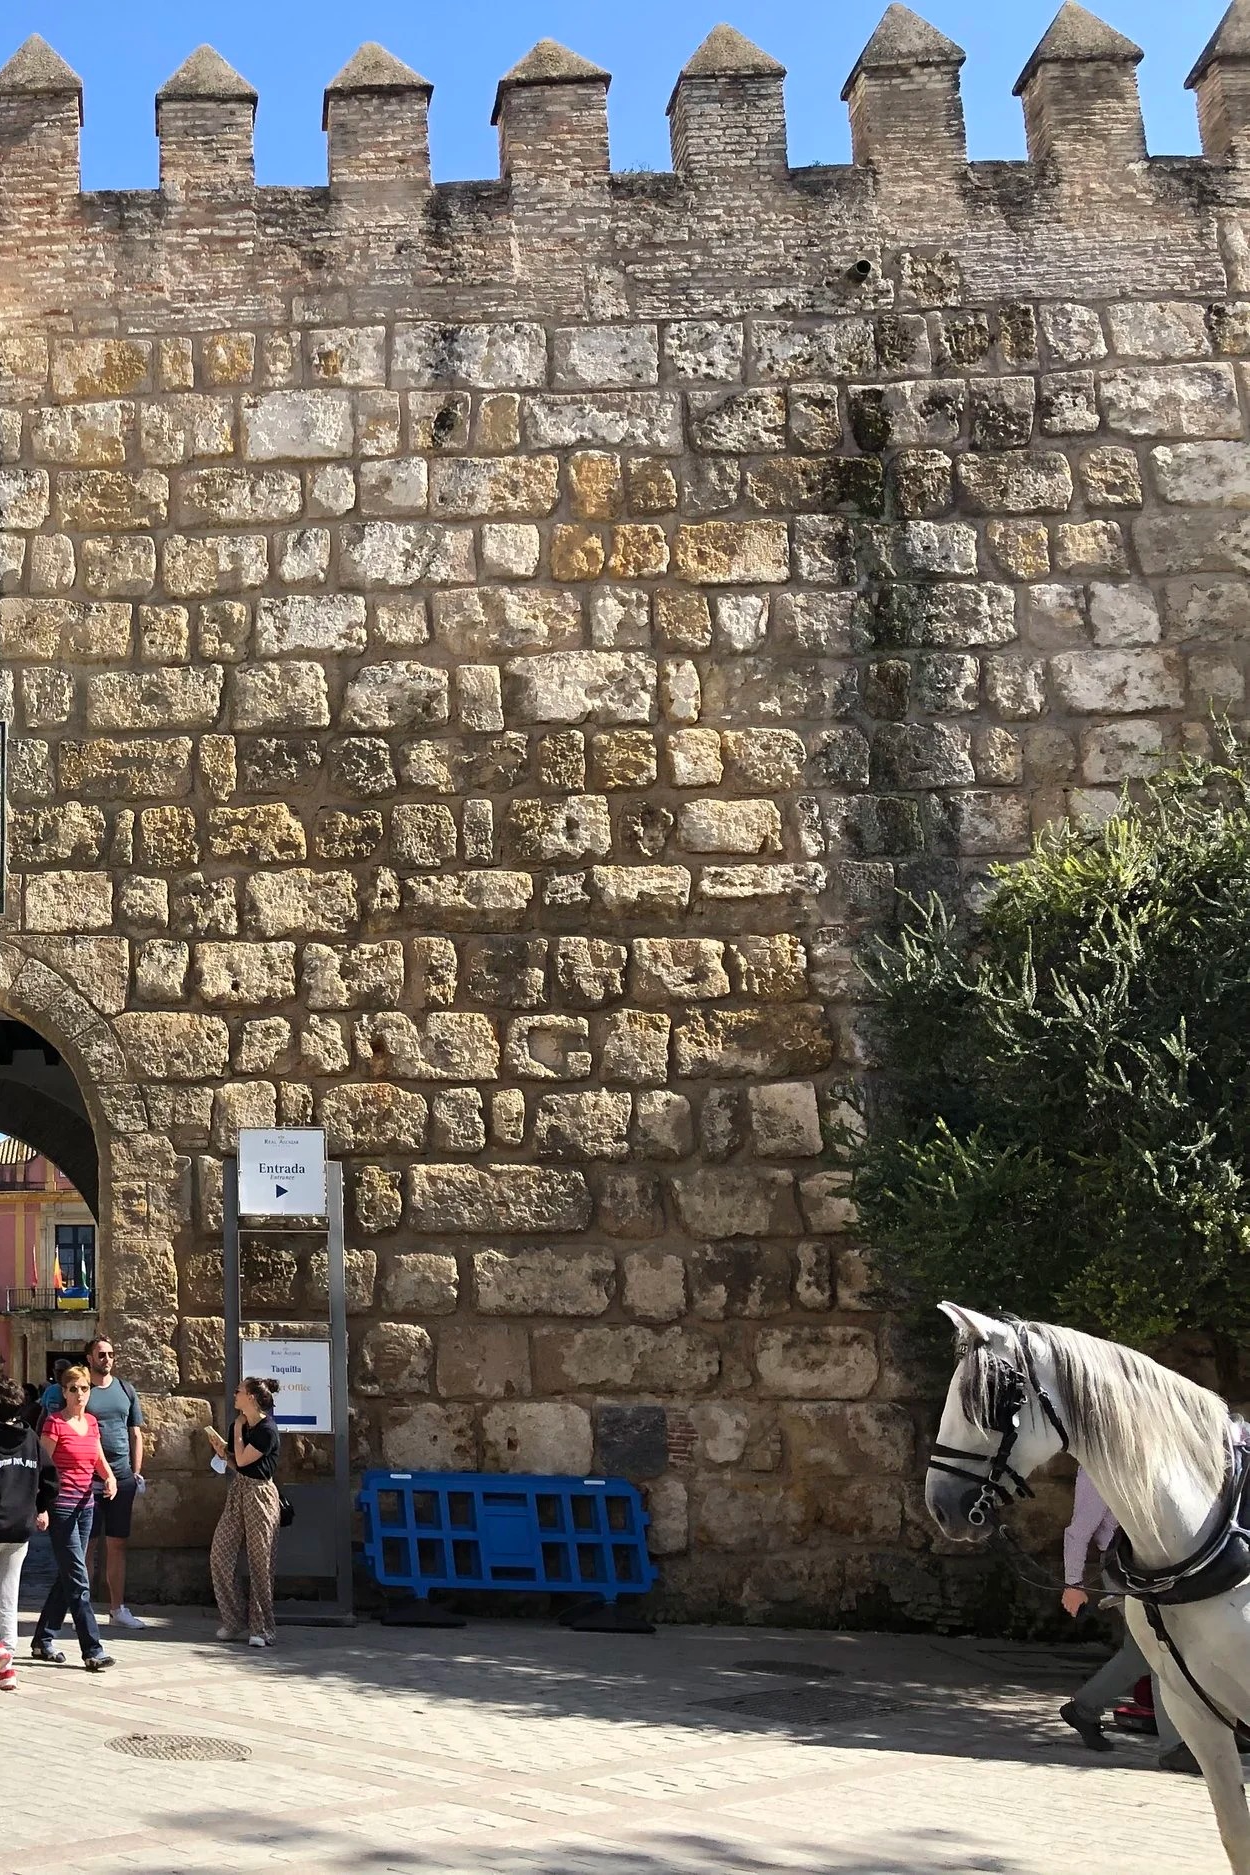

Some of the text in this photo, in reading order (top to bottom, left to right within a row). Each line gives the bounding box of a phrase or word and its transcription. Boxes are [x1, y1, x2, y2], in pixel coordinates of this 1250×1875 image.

[259, 1163, 305, 1174] Entrada
[271, 1365, 301, 1374] Taquilla
[287, 1384, 311, 1392] Office
